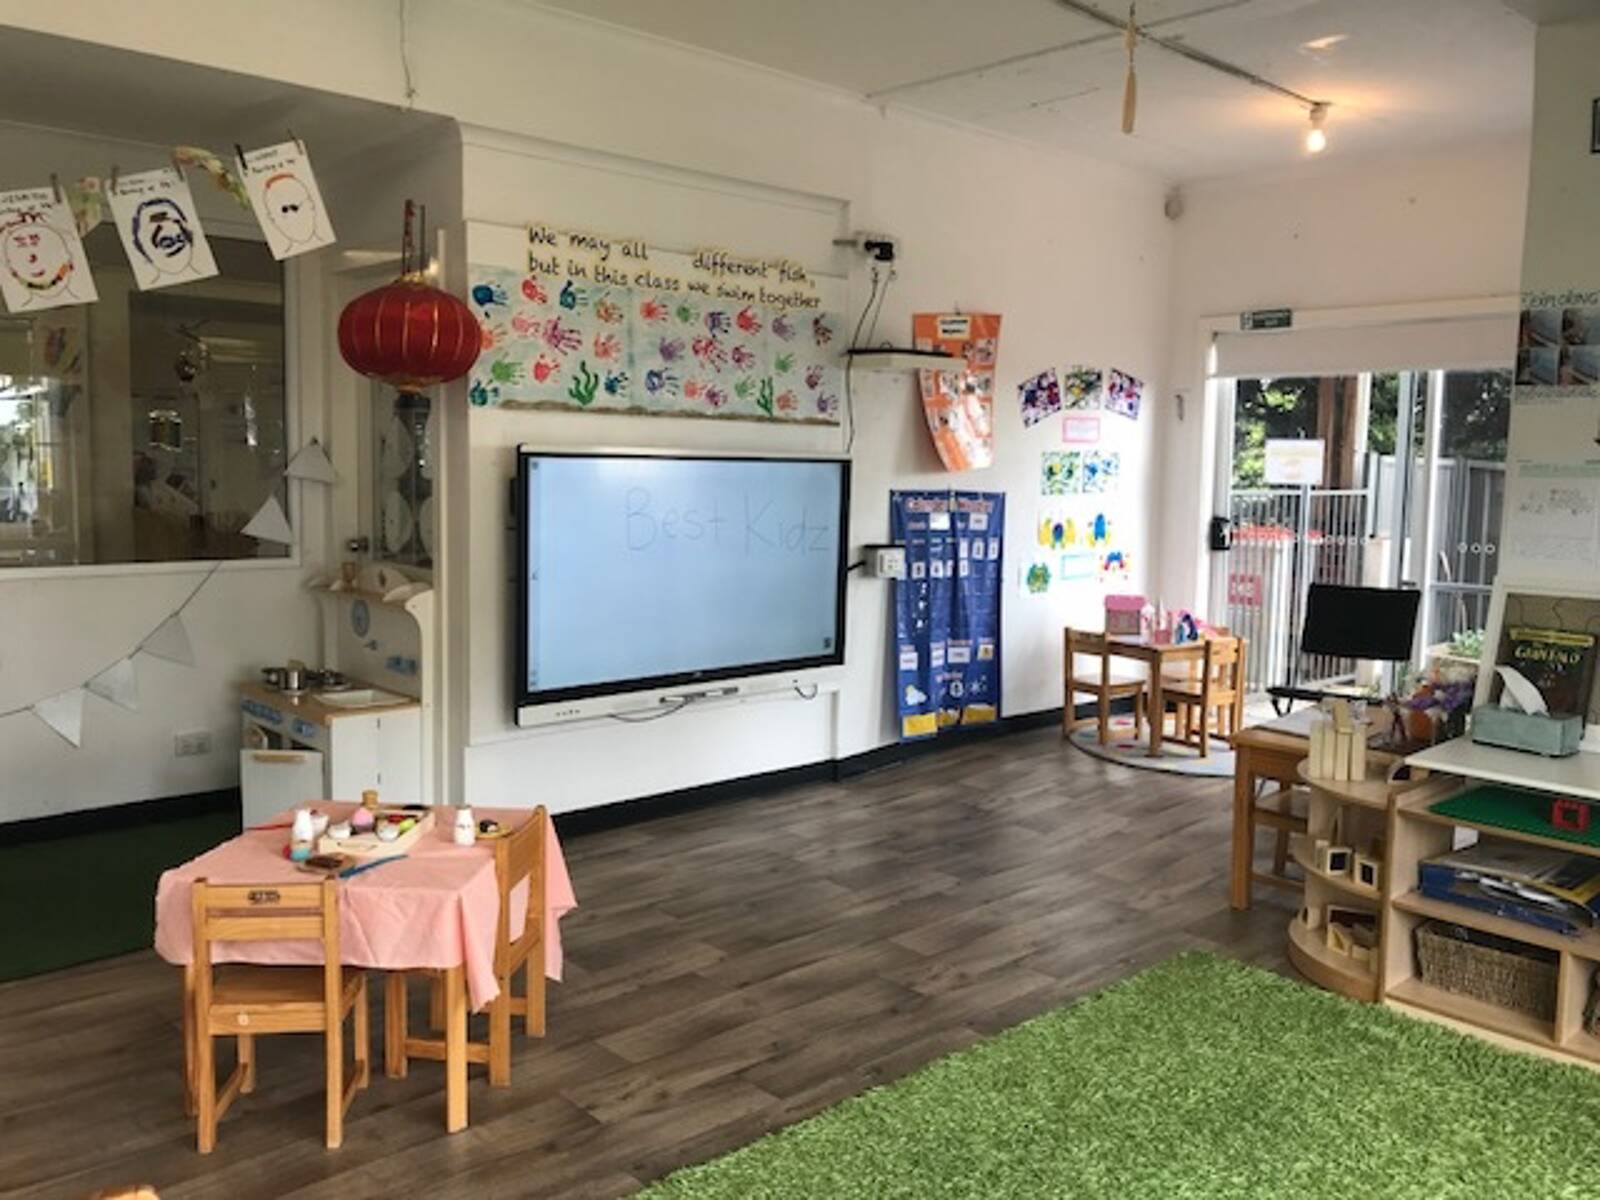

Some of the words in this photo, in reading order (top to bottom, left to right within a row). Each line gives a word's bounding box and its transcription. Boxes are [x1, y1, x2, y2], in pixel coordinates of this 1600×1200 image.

[528, 226, 557, 246] We
[569, 233, 610, 261] may
[621, 241, 648, 260] all
[692, 251, 768, 279] different
[528, 249, 560, 276] but
[567, 259, 587, 279] in
[594, 264, 629, 286] this
[634, 270, 680, 292] class
[687, 282, 710, 295] we
[716, 284, 755, 302] swim
[759, 286, 822, 311] together
[625, 486, 729, 552] Best
[743, 490, 832, 557] Kidz
